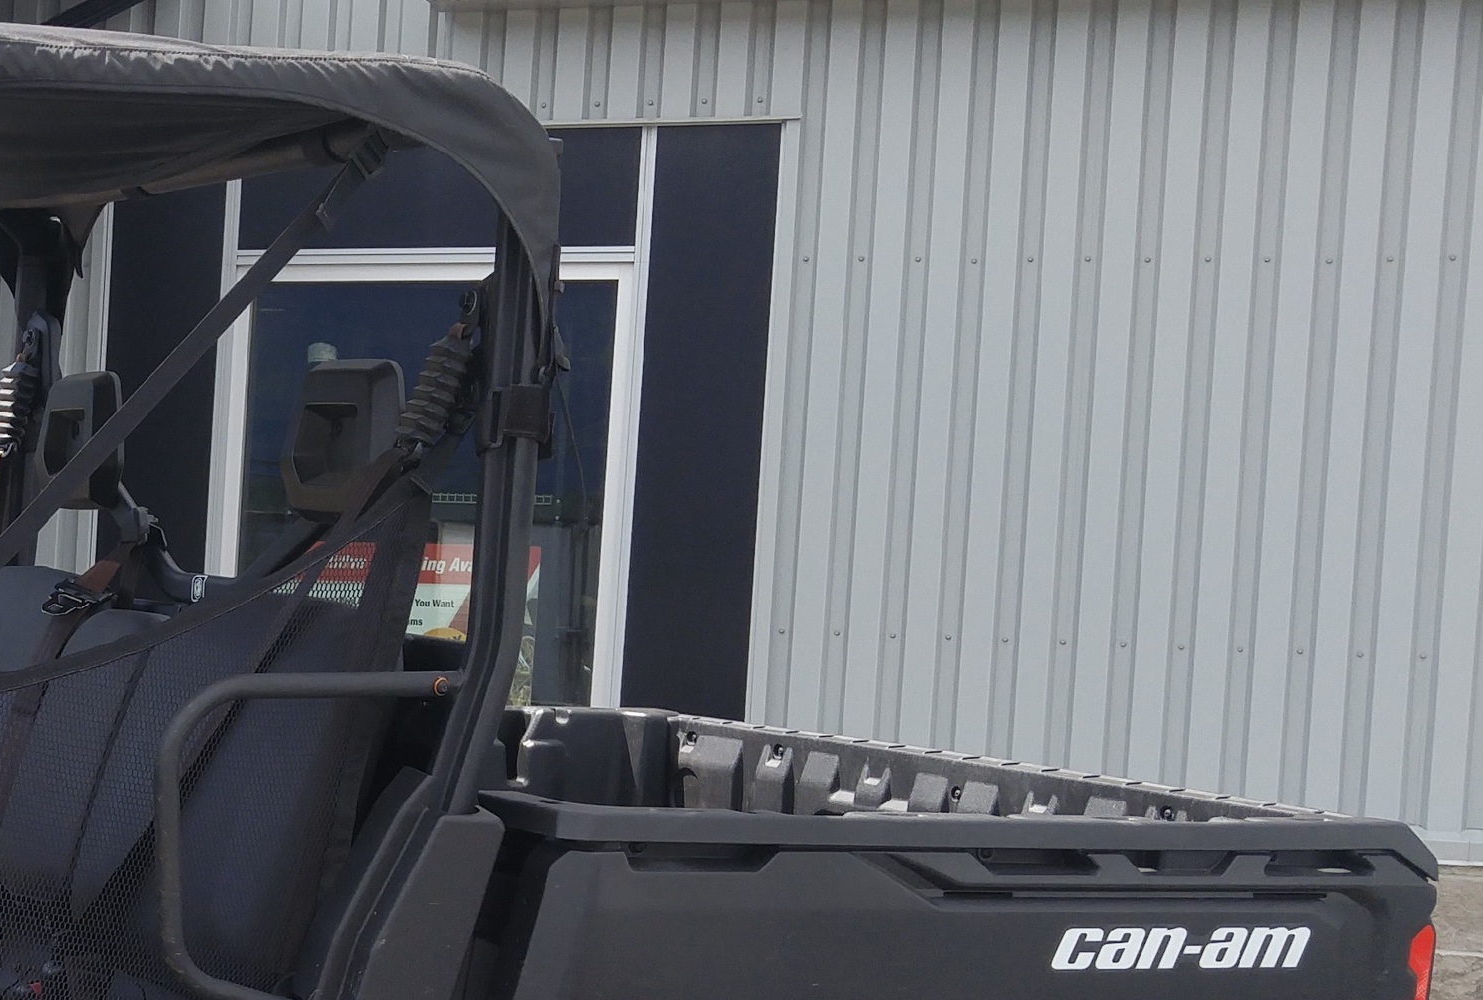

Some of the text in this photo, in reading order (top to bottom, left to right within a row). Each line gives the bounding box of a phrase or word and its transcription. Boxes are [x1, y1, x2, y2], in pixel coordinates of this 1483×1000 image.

[420, 556, 473, 575] ing Ava
[414, 599, 455, 608] You Want
[410, 618, 423, 626] ms
[1050, 926, 1312, 970] can-am
